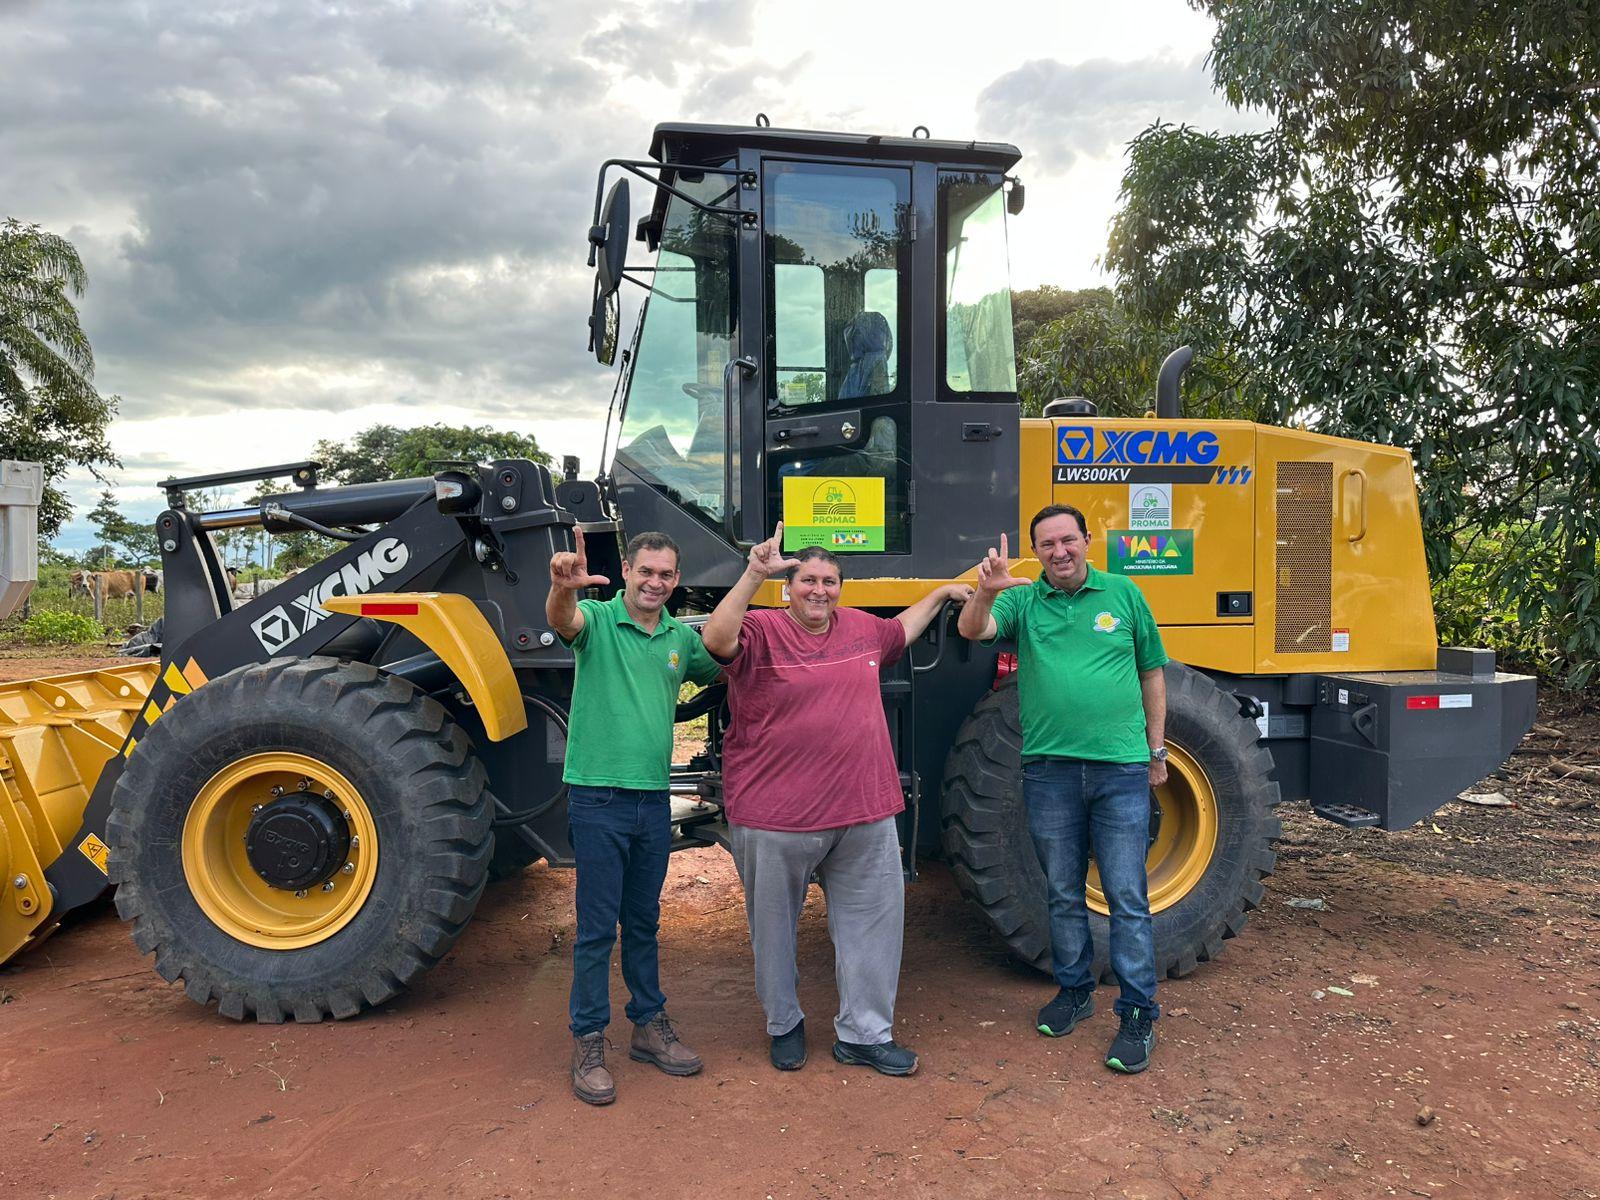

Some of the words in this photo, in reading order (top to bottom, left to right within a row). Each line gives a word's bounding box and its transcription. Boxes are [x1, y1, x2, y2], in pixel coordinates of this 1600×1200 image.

[1094, 430, 1220, 465] XCMG
[1057, 467, 1132, 482] LW300KV
[812, 515, 857, 524] PROMAQ
[1131, 519, 1170, 528] PROMAQ
[290, 537, 410, 636] XCMG
